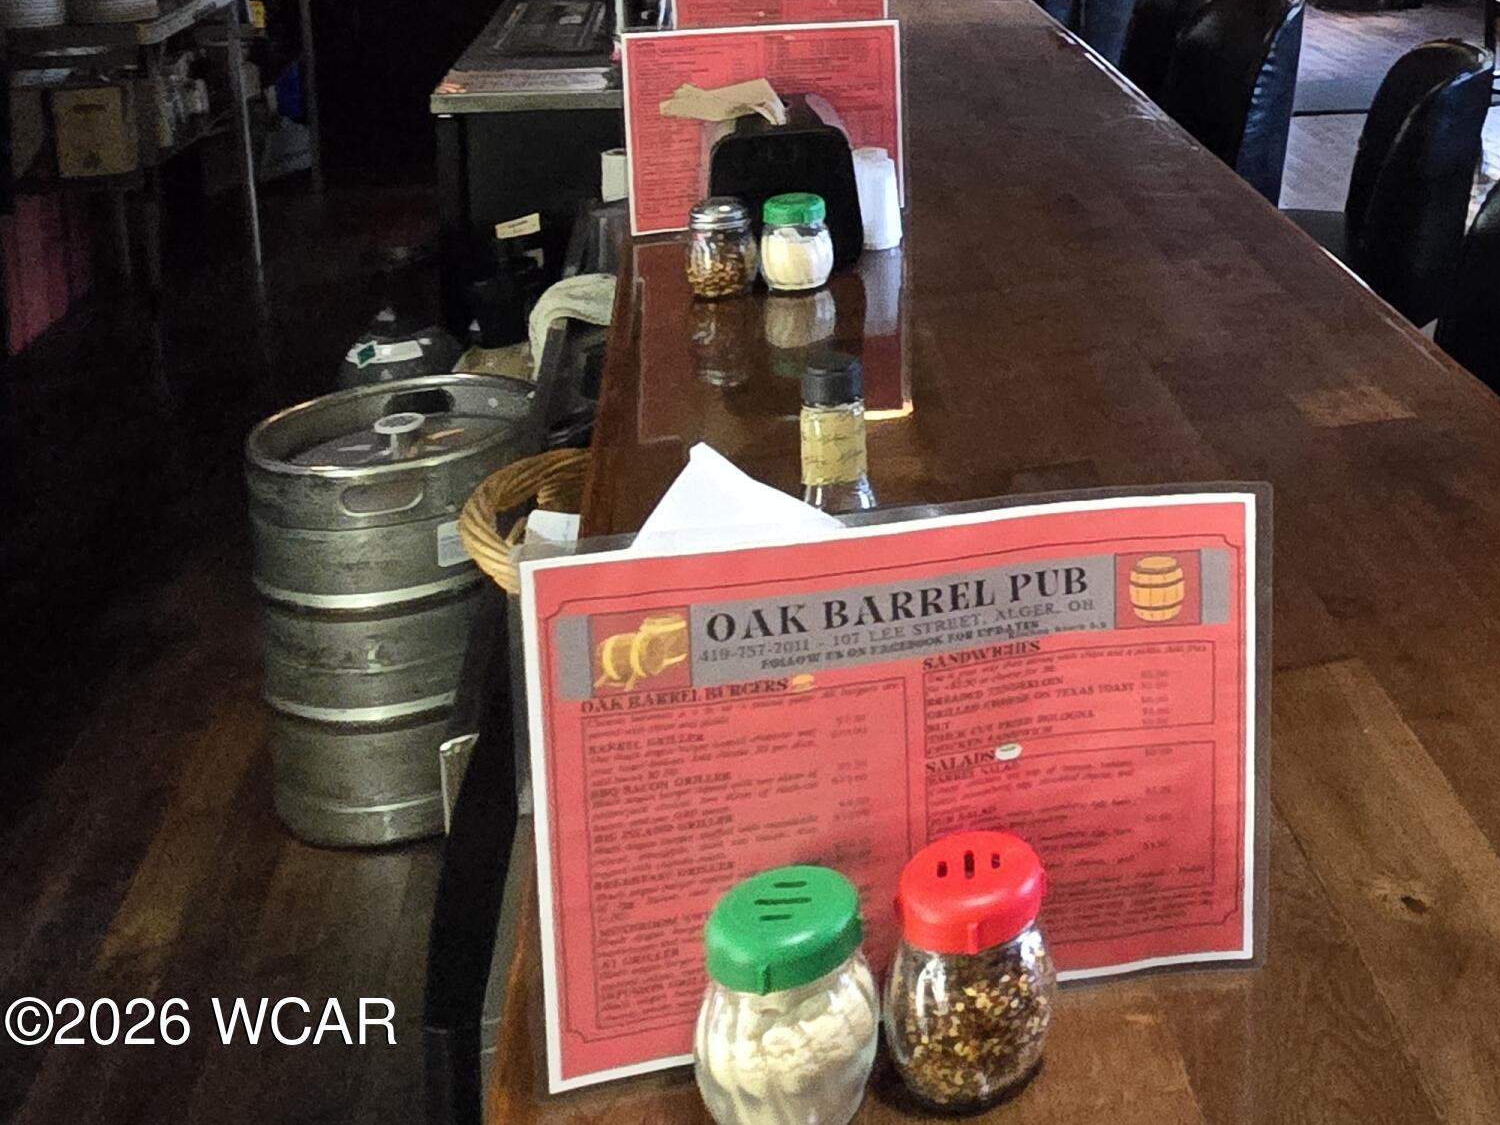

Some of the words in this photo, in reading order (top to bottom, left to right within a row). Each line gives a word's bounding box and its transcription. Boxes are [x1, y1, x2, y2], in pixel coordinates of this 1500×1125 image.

[706, 604, 809, 642] OAK
[822, 579, 995, 630] BARREL
[1009, 566, 1088, 603] PUB
[833, 632, 860, 647] 107
[869, 627, 906, 642] LEE
[1068, 599, 1095, 612] OH
[922, 640, 1040, 670] SANDWICHES
[581, 697, 622, 713] OAK
[628, 688, 698, 710] BARREL
[705, 678, 789, 701] BURGERS
[925, 751, 996, 774] SALADS
